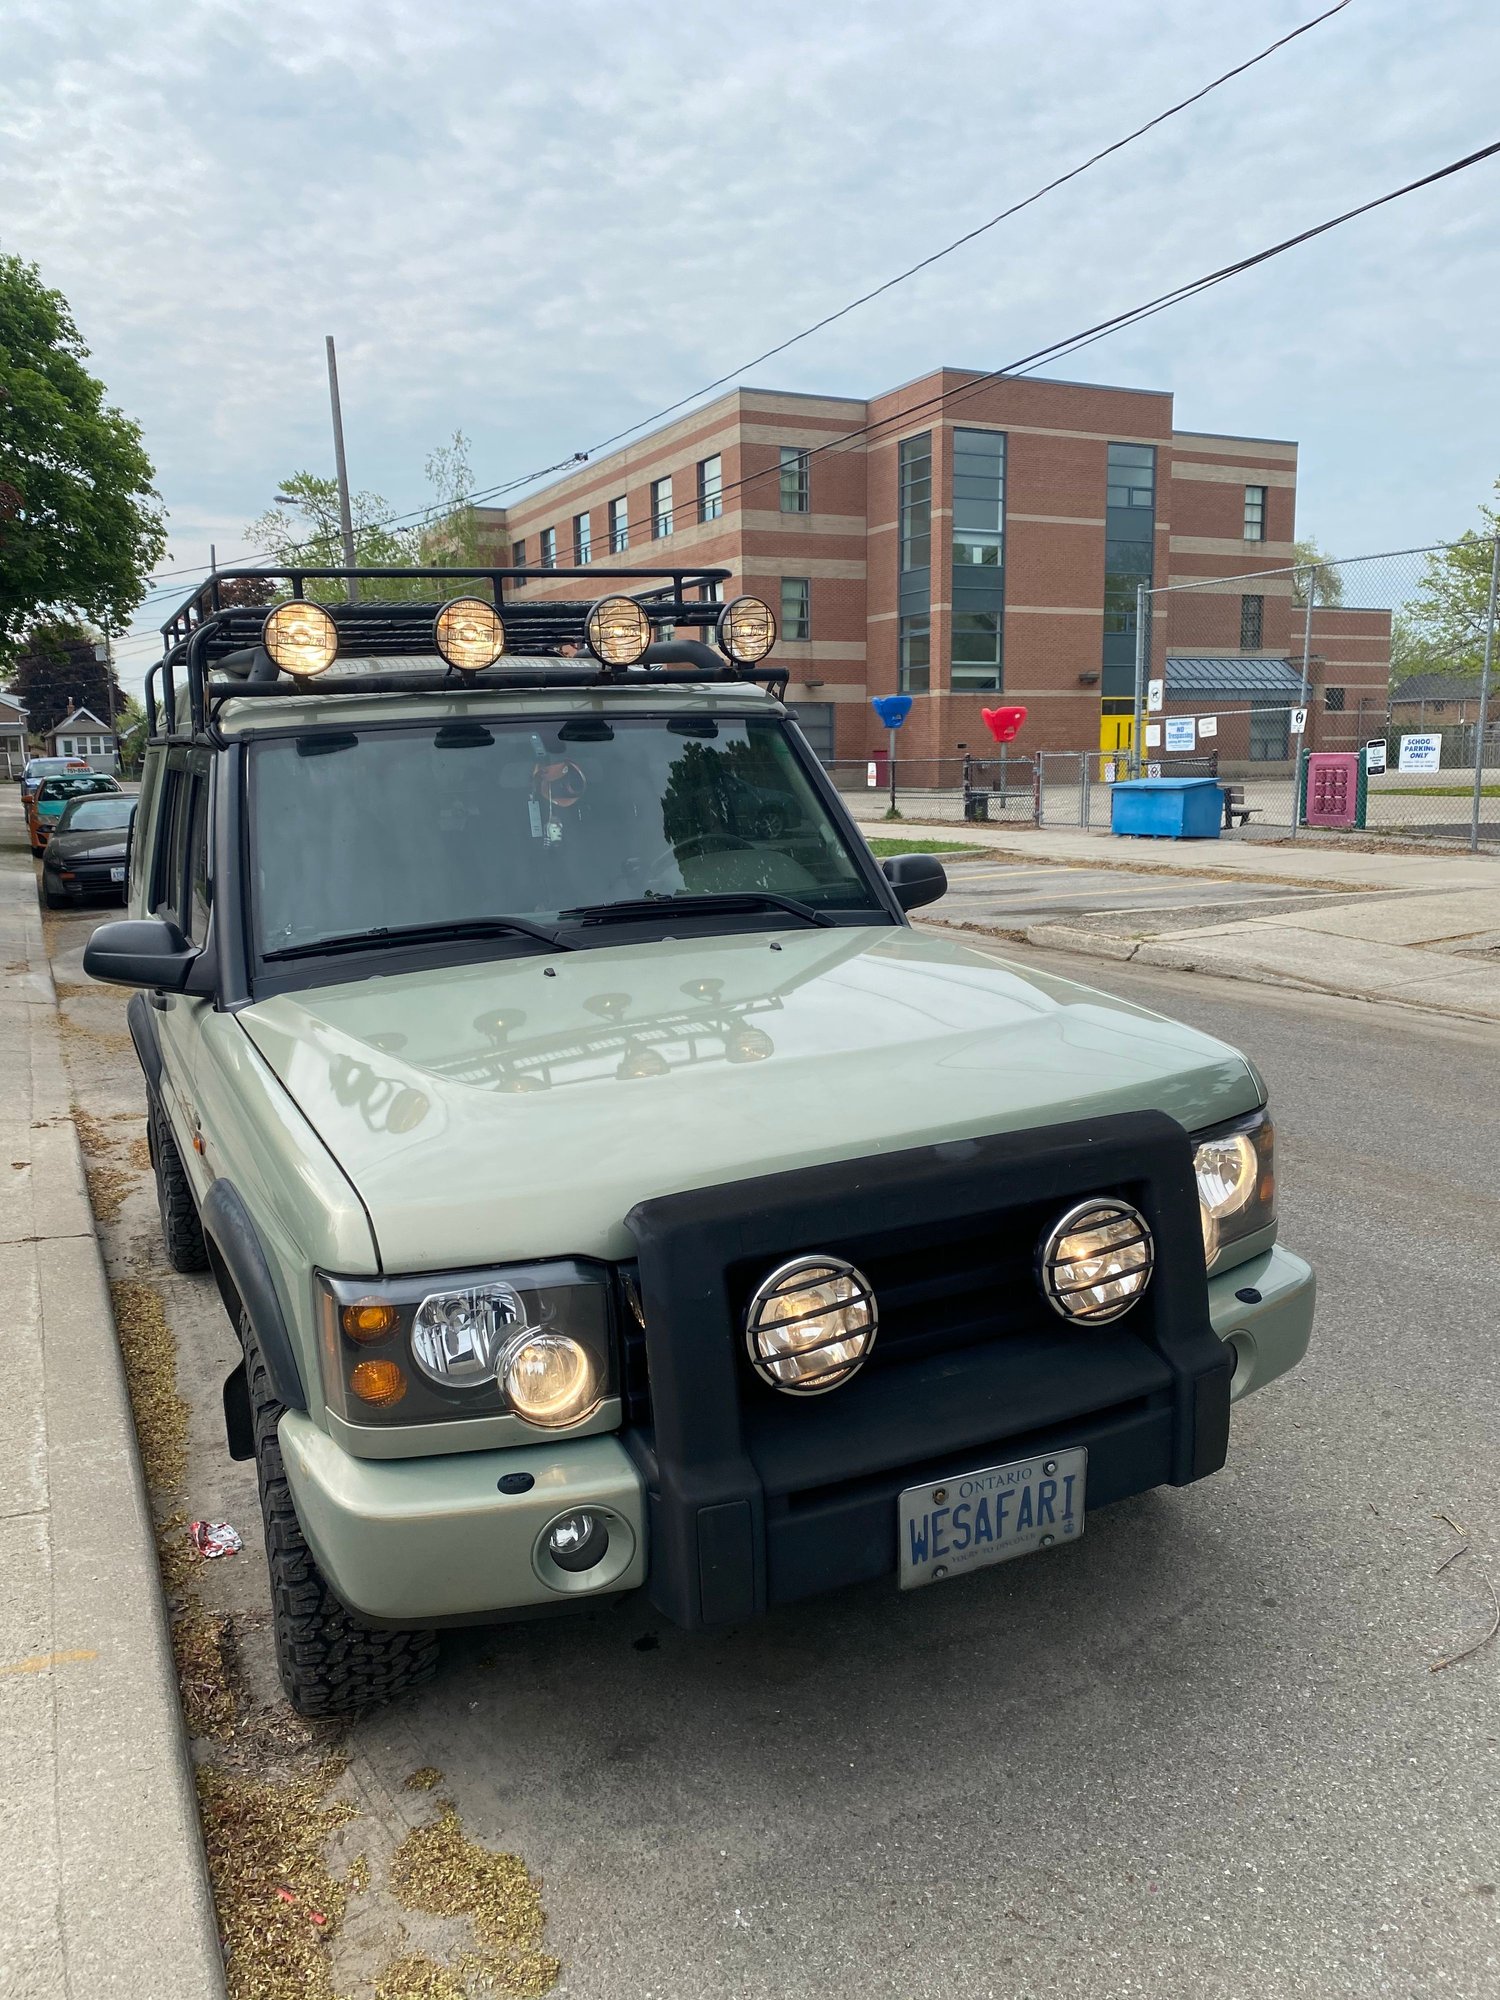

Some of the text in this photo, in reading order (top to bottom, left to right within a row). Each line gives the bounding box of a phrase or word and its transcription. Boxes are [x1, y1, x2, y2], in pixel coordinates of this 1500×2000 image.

[959, 1468, 1033, 1499] ONTARIO
[909, 1474, 1076, 1566] WESAFARI
[951, 1550, 979, 1563] YOURS
[996, 1532, 1037, 1552] DISCOVER
